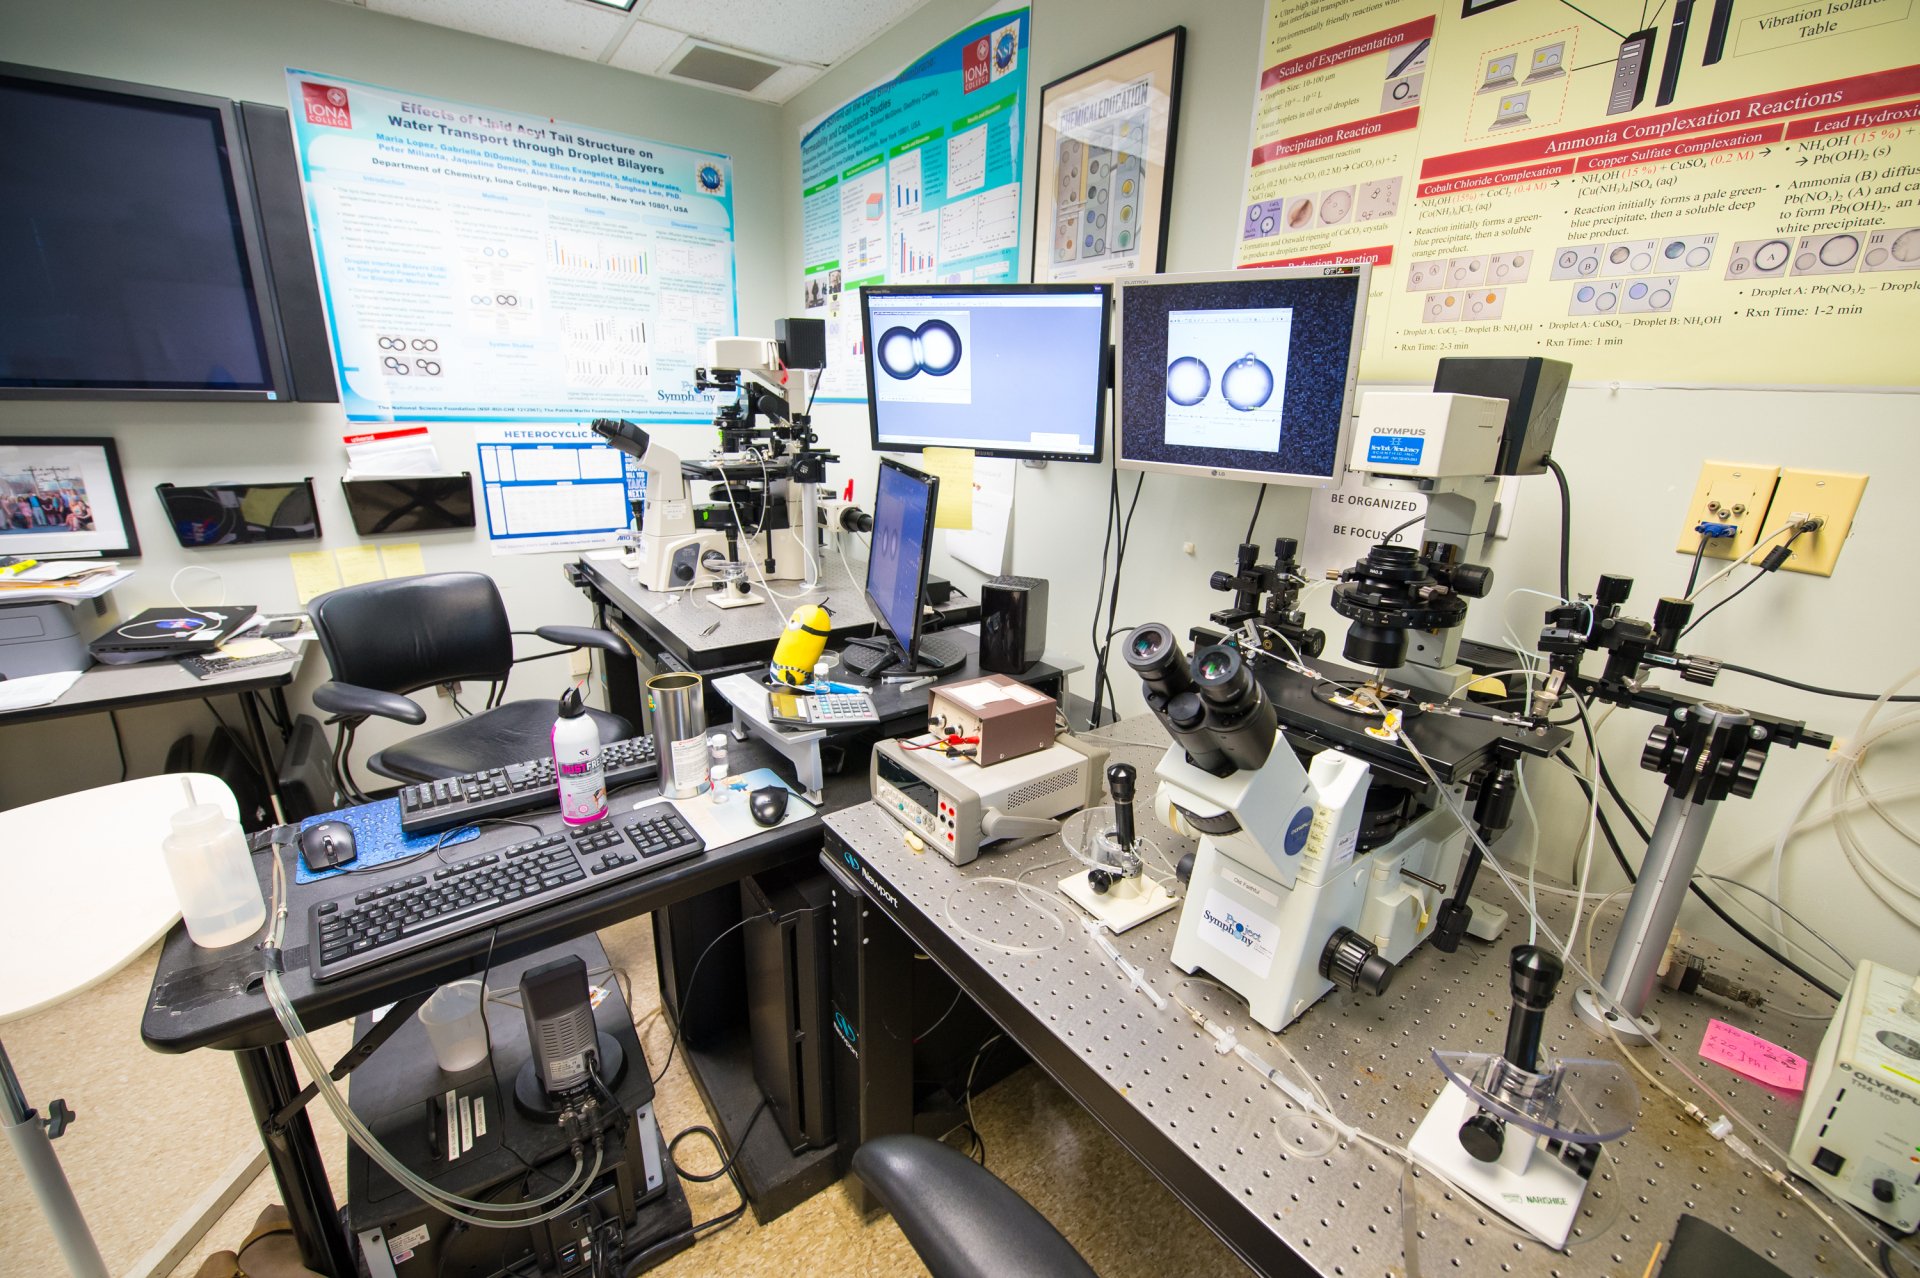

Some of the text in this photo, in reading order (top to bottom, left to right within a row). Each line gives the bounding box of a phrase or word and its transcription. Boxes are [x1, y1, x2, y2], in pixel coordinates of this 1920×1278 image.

[1276, 2, 1382, 44] Environmentally friendly reactions
[1290, 6, 1319, 24] interfacial
[1758, 9, 1822, 30] Vibration
[1799, 21, 1838, 38] Table
[1279, 32, 1404, 78] Scale of Experimentation
[964, 62, 989, 82] IONA
[965, 75, 989, 91] COLLEGE
[1286, 76, 1324, 93] Size: 10-100
[1334, 96, 1360, 110] droplets
[306, 102, 350, 128] IONA COLLEGE
[1544, 88, 1844, 154] Ammonia Complexation Reactions
[1814, 118, 1850, 132] Lead
[401, 101, 454, 122] Effects
[460, 114, 474, 125] of
[517, 124, 546, 140] Acyl
[550, 130, 573, 144] Tail
[577, 137, 636, 156] Structure
[640, 150, 654, 160] on
[1276, 132, 1334, 156] Precipitation
[1336, 122, 1382, 142] Reaction
[1799, 128, 1901, 152] NH4OH (15 %)
[388, 115, 665, 175] Water Transport through Droplet Bilayers
[1589, 134, 1762, 168] Copper Sulfate Complexation
[1813, 145, 1892, 165] Pb(OH)2 (s)
[376, 133, 682, 194] Maria Lopez, Gabriella DiDomizio, Sue Ellen Evangelista, Melissa Morales,
[1298, 148, 1361, 168] replacement reaction
[1622, 168, 1638, 178] (15
[1710, 153, 1732, 166] (0.2
[1737, 150, 1755, 162] M)
[378, 143, 404, 154] Peter
[532, 169, 577, 182] Alessandra
[666, 191, 682, 200] PhD.
[1424, 166, 1562, 194] Cobalt Chloride Complexation
[1656, 175, 1678, 188] (aq)
[1788, 165, 1920, 190] Ammonia (B) diffus
[372, 156, 688, 214] Department of Chemistry, Iona College, New Rochelle, New York 10801, USA
[1848, 186, 1871, 198] (A)
[1874, 182, 1900, 194] and
[1574, 186, 1766, 216] Reaction initially forms pale green-
[1780, 200, 1912, 220] to form an
[1416, 214, 1542, 236] Reaction initially forms green-
[1570, 201, 1756, 229] blue precipitate, then soluble deep
[1362, 223, 1389, 234] crystals
[1568, 226, 1630, 241] blue product.
[1776, 218, 1886, 234] white precipitate.
[1414, 226, 1532, 247] blue precipitate, then soluble
[1336, 254, 1379, 265] Reaction
[1412, 245, 1469, 258] orange product.
[1751, 287, 1792, 298] Droplet
[1746, 305, 1863, 318] Rxn Time: 1-2 min
[1464, 326, 1491, 334] Droplet
[1549, 318, 1667, 330] Droplet Droplet
[1546, 337, 1623, 346] Rxn Time: min
[504, 430, 588, 438] HETEROCYCLIC
[1373, 427, 1426, 436] OLYMPUS
[627, 480, 646, 489] TAKE
[1331, 494, 1417, 512] BE ORGANIZED
[1333, 525, 1347, 535] BE
[862, 866, 898, 909] Newport
[1204, 909, 1254, 947] Symphony
[1854, 1071, 1920, 1107] OLYMPU
[1526, 1195, 1568, 1206] NARISHIGE
